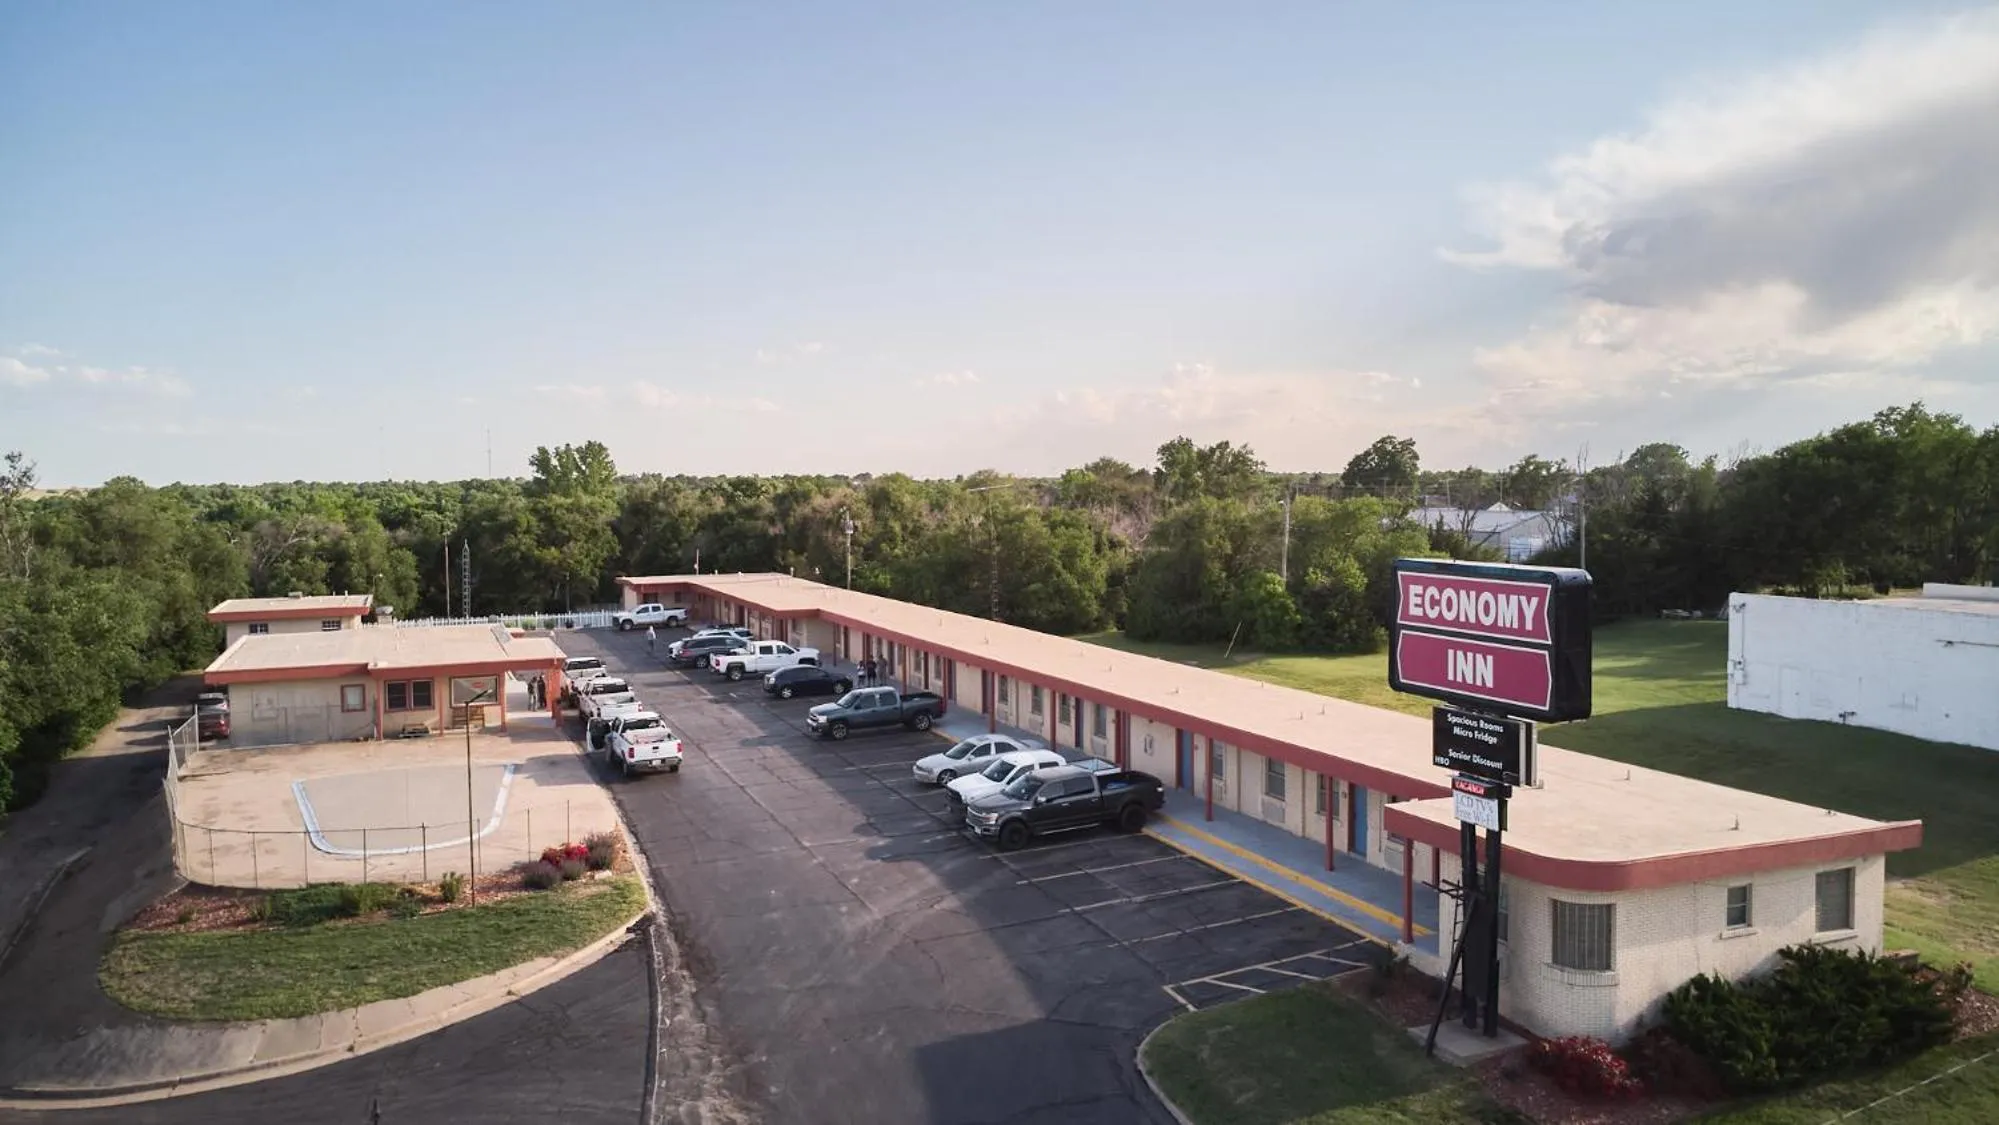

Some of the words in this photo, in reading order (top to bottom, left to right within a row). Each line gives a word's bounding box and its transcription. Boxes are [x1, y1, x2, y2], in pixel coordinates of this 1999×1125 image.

[1408, 585, 1539, 631] ECONOMY
[1447, 649, 1494, 688] INN
[1447, 713, 1478, 727] Spacious
[1480, 720, 1504, 732] Rooms
[1453, 726, 1473, 738] Micro
[1474, 731, 1497, 744] Fridge
[1434, 756, 1450, 766] HBO
[1448, 748, 1471, 761] Senior
[1472, 754, 1503, 769] Discount
